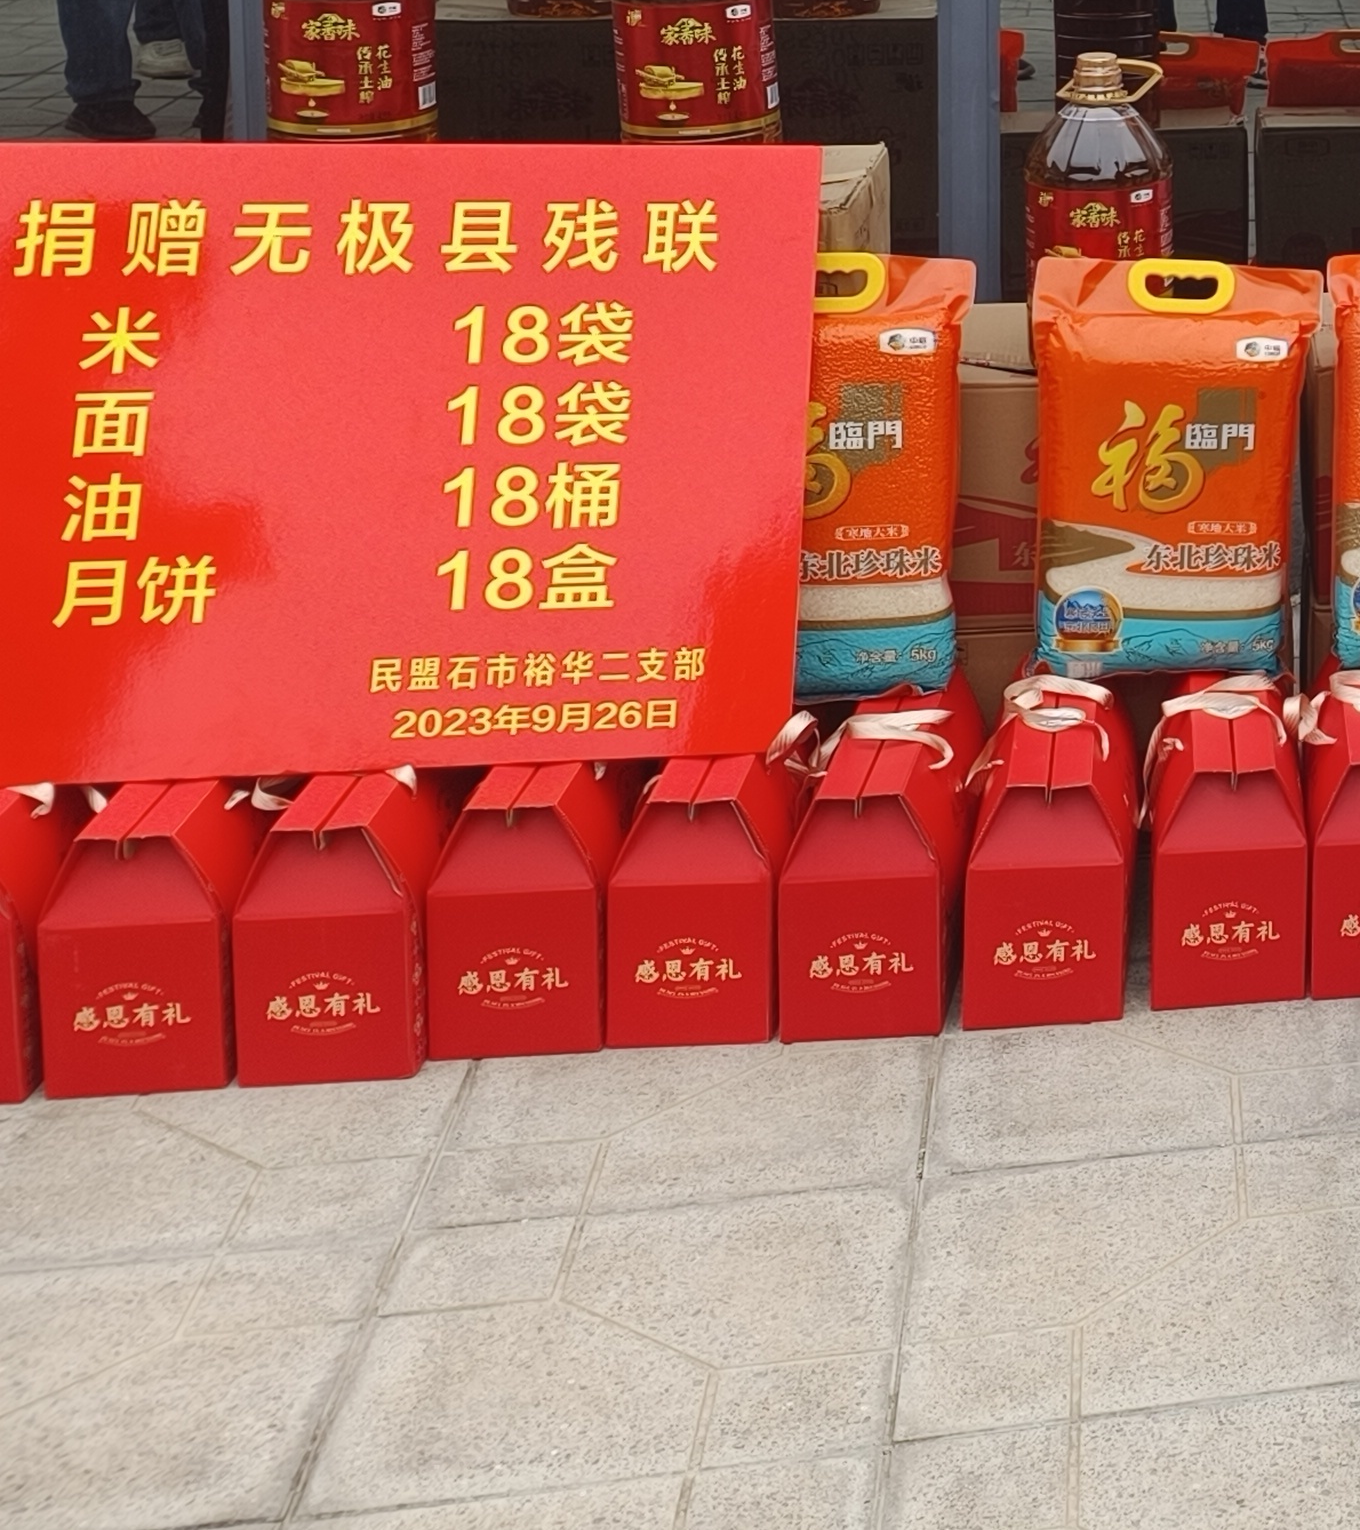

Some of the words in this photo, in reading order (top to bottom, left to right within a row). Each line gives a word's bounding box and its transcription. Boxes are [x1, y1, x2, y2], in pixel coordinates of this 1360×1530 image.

[14, 198, 721, 278] 捐赠无极县残联
[78, 306, 162, 375] 米
[451, 300, 636, 368] 18袋
[71, 388, 156, 458] 面
[445, 379, 634, 448] 18袋
[59, 474, 143, 544] 油
[441, 459, 623, 530] 18桶
[1142, 542, 1282, 574] 东北珍珠米
[51, 553, 219, 630] 月饼
[434, 542, 619, 614] 18盒
[369, 646, 708, 694] 民盟石市裕华二支部
[390, 699, 680, 741] 2023年9月26日
[1181, 920, 1280, 947] 感恩有礼
[809, 951, 914, 979] 感恩有礼
[993, 939, 1097, 966] 感恩有礼
[457, 967, 569, 995] 感恩有礼
[634, 957, 743, 984] 感恩有礼
[74, 1002, 192, 1032] 感恩有礼
[265, 992, 381, 1020] 感恩有礼
